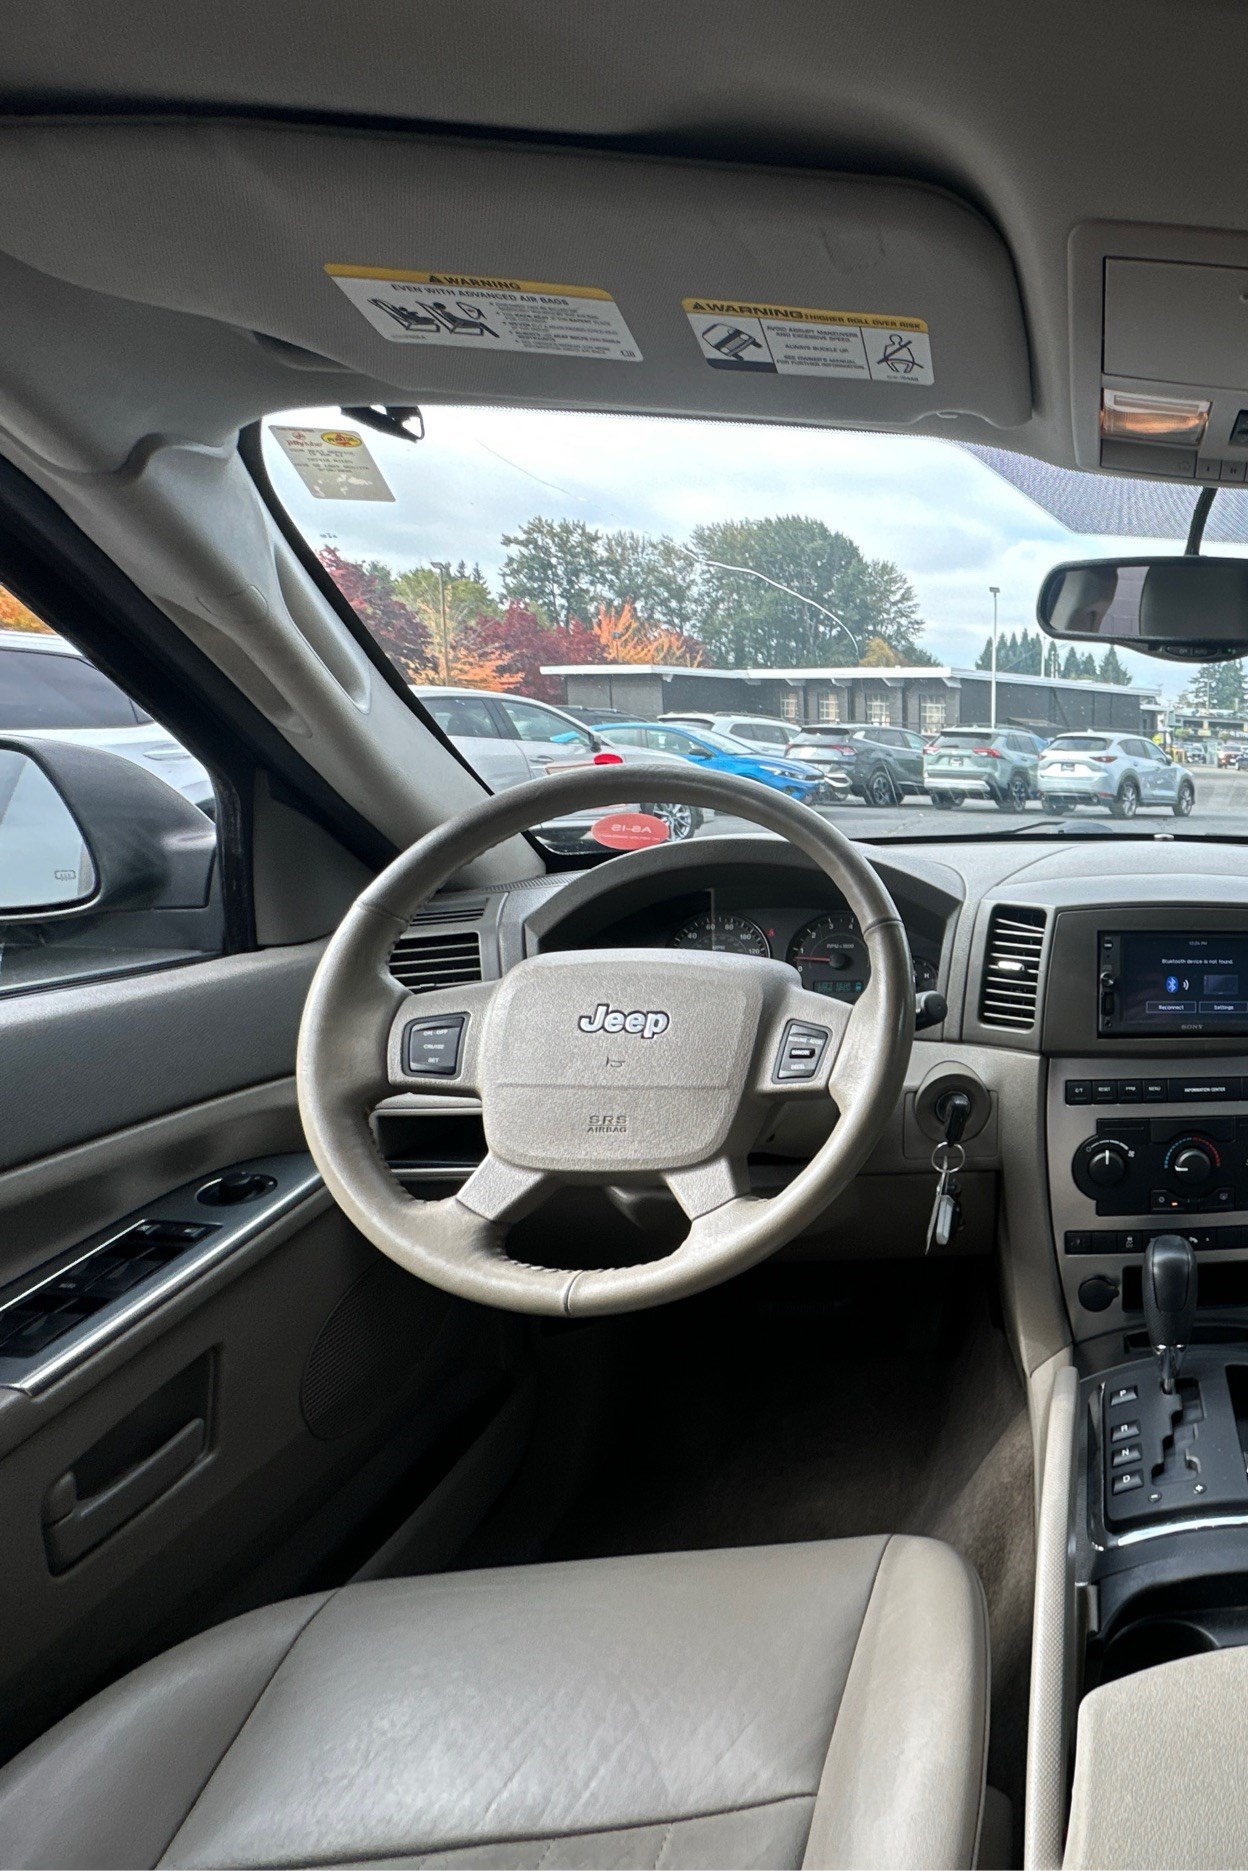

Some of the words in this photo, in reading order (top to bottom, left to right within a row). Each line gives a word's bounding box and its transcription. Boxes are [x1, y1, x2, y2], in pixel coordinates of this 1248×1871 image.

[444, 275, 521, 291] WARNING
[391, 283, 422, 294] EVEN
[427, 286, 456, 297] WITH
[458, 288, 518, 302] ADVANCED
[519, 294, 541, 304] AIR
[541, 296, 570, 307] BAGS
[810, 313, 845, 324] HIGHER
[847, 316, 870, 326] ROLL
[872, 319, 897, 328] OVER
[899, 321, 921, 330] RISK
[739, 933, 752, 941] 100
[1213, 1004, 1234, 1012] Settings
[579, 1003, 669, 1038] Jeep
[589, 1114, 627, 1125] SRS
[587, 1126, 628, 1134] AIRBAG
[1119, 1389, 1128, 1398] P
[1120, 1424, 1129, 1433] R
[1121, 1448, 1130, 1457] N
[1122, 1474, 1131, 1484] D
